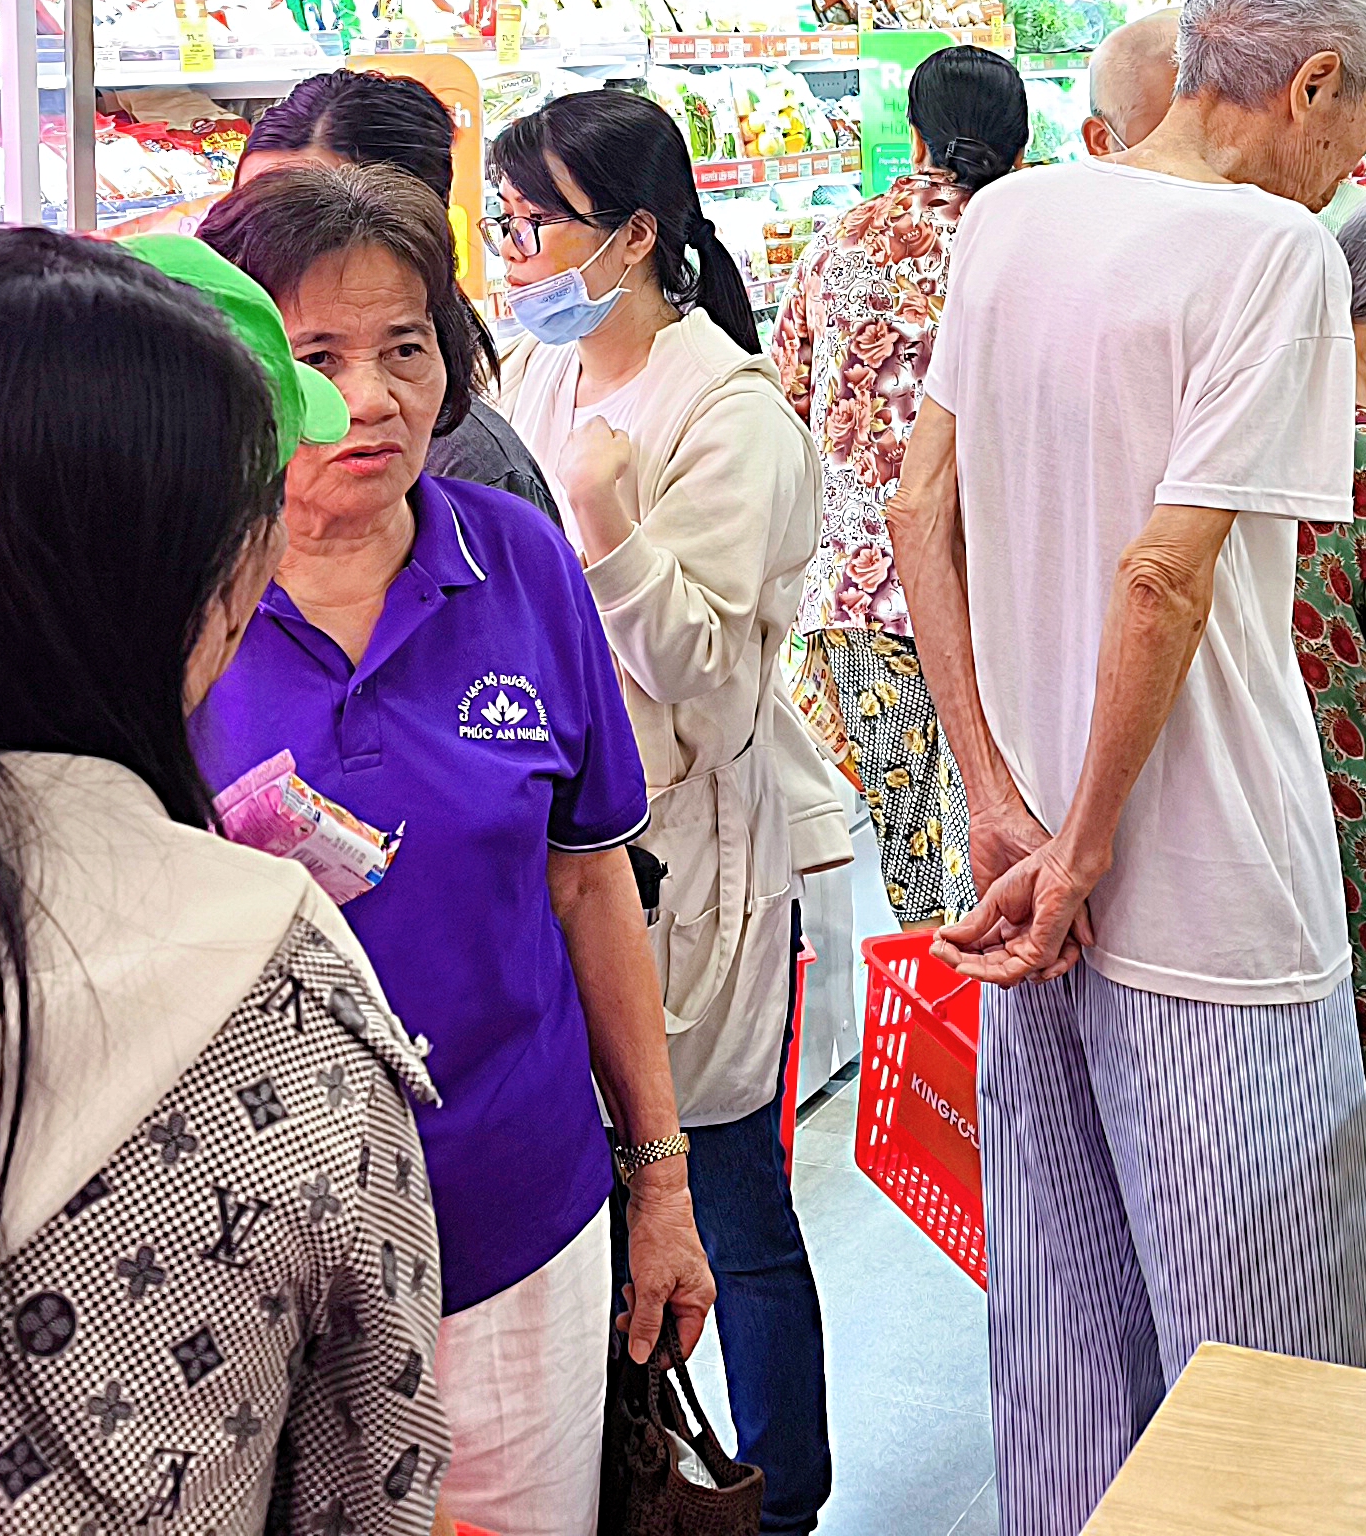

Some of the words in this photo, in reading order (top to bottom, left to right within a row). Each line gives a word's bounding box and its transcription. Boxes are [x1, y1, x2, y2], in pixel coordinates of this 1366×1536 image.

[499, 674, 537, 699] DƯỠNG
[458, 723, 494, 740] PHÚC
[495, 727, 515, 740] AN
[516, 725, 550, 742] NHIÊN
